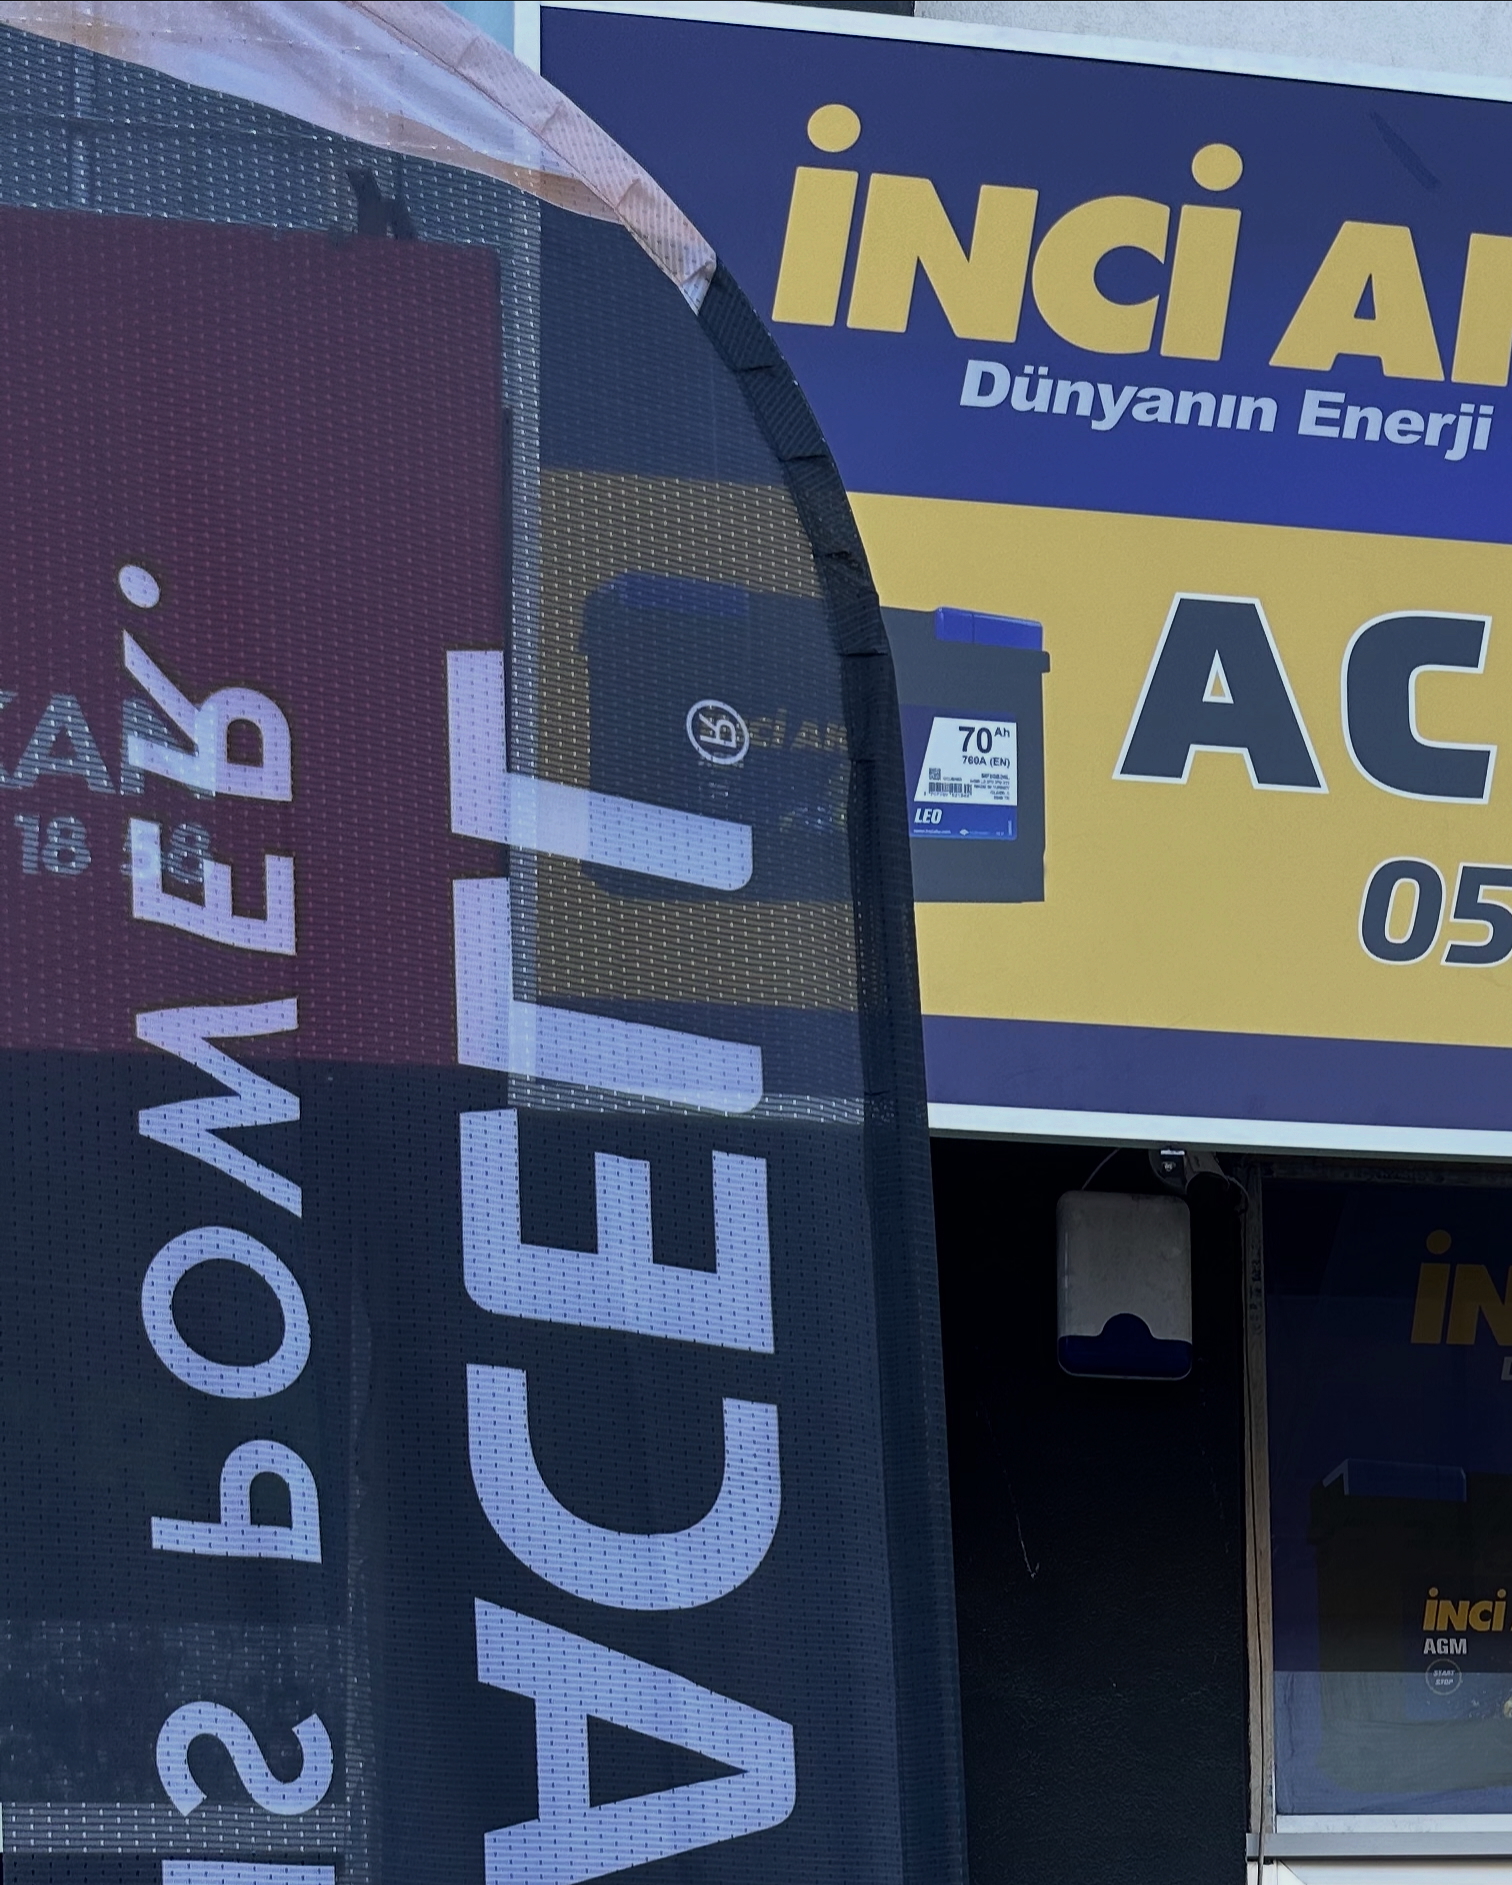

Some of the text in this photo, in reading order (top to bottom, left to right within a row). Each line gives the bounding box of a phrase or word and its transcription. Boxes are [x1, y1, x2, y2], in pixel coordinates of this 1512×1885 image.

[772, 104, 1243, 361] İNCİ
[959, 358, 1277, 433] Dünyanın
[1297, 389, 1493, 463] Enerji
[962, 755, 987, 767] 760A
[914, 807, 942, 825] LEO
[13, 813, 92, 876] 18
[1422, 1586, 1508, 1632] İNCİ
[1423, 1638, 1468, 1655] AGM
